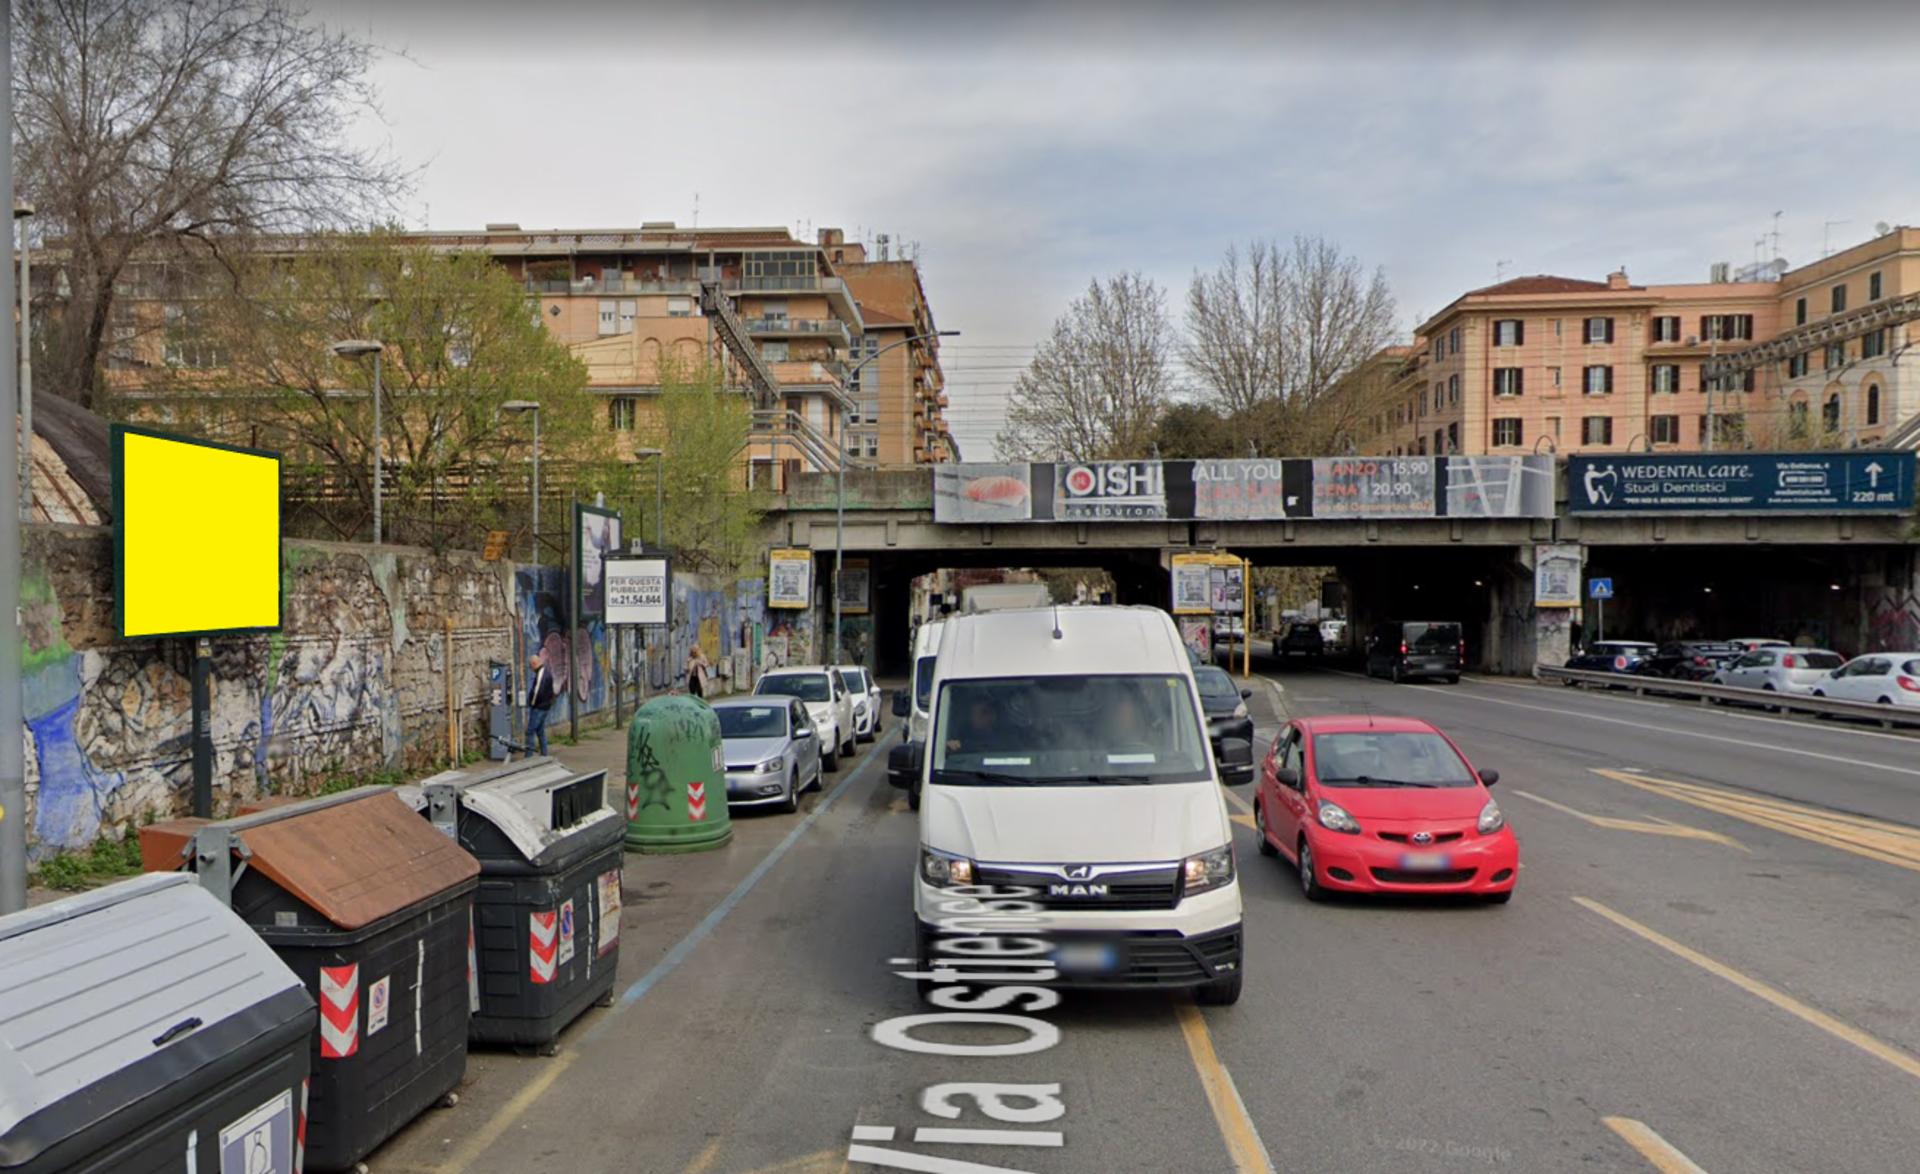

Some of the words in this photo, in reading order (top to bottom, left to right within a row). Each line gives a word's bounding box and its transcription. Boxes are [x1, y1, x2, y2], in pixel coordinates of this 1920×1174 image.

[1197, 464, 1235, 481] ALL
[1241, 464, 1282, 480] YOU
[1622, 465, 1706, 478] WEDENTAL
[1066, 465, 1164, 496] OISHI
[1624, 482, 1659, 493] Studi
[1663, 482, 1727, 493] Dentistici
[1853, 491, 1875, 502] 220
[1876, 491, 1895, 502] mt
[610, 577, 626, 586] PER
[628, 577, 662, 586] QUESTA
[1049, 884, 1108, 897] MAN
